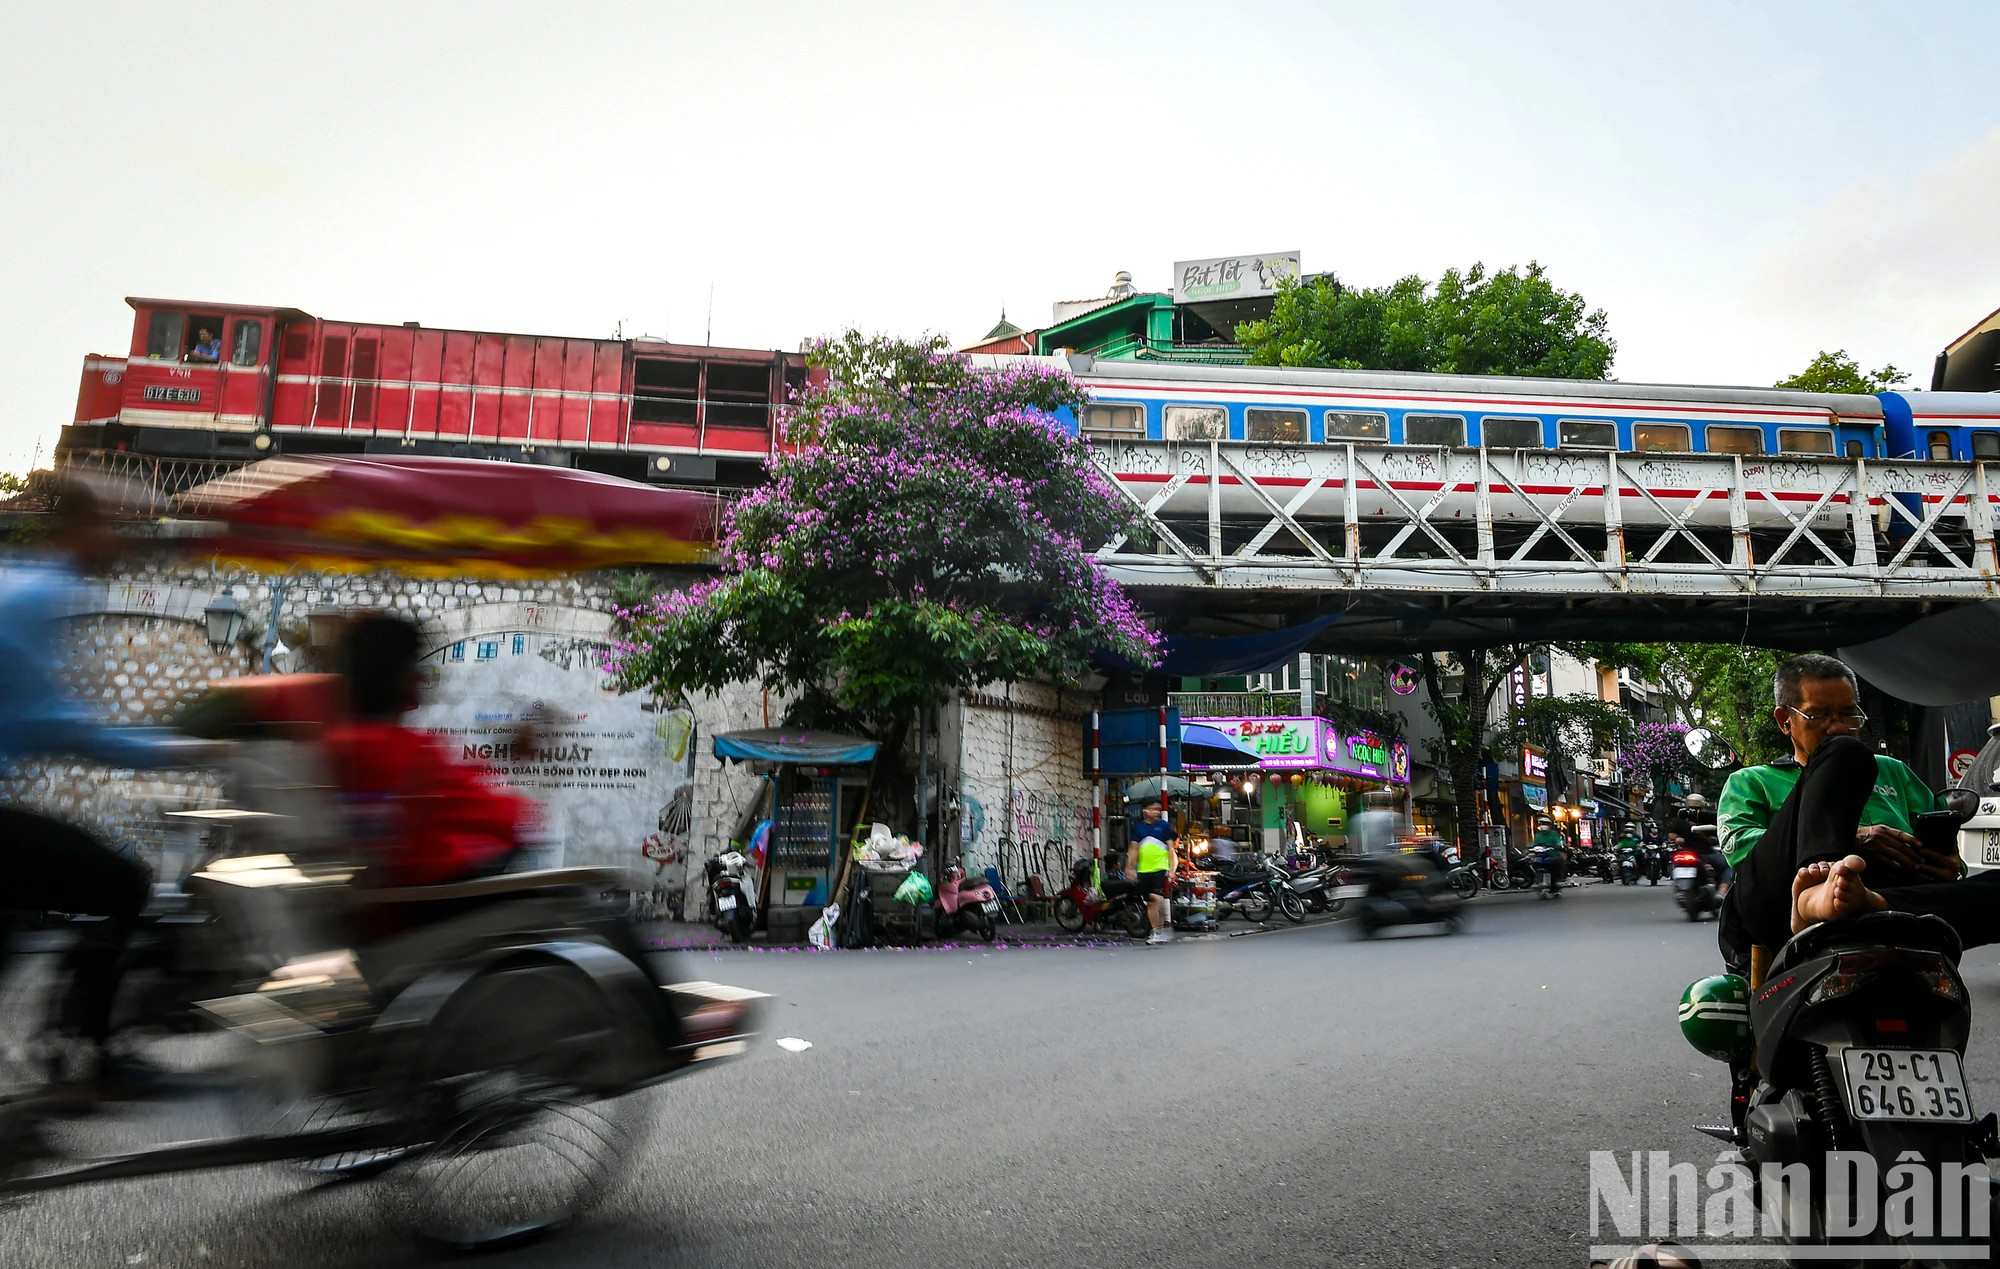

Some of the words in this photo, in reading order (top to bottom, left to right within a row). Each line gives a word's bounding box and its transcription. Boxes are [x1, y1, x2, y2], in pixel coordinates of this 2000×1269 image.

[1256, 727, 1309, 753] HIẾU
[543, 765, 574, 777] SỐNG
[1860, 1052, 1945, 1083] 29-C1
[1857, 1084, 1965, 1118] 646.35
